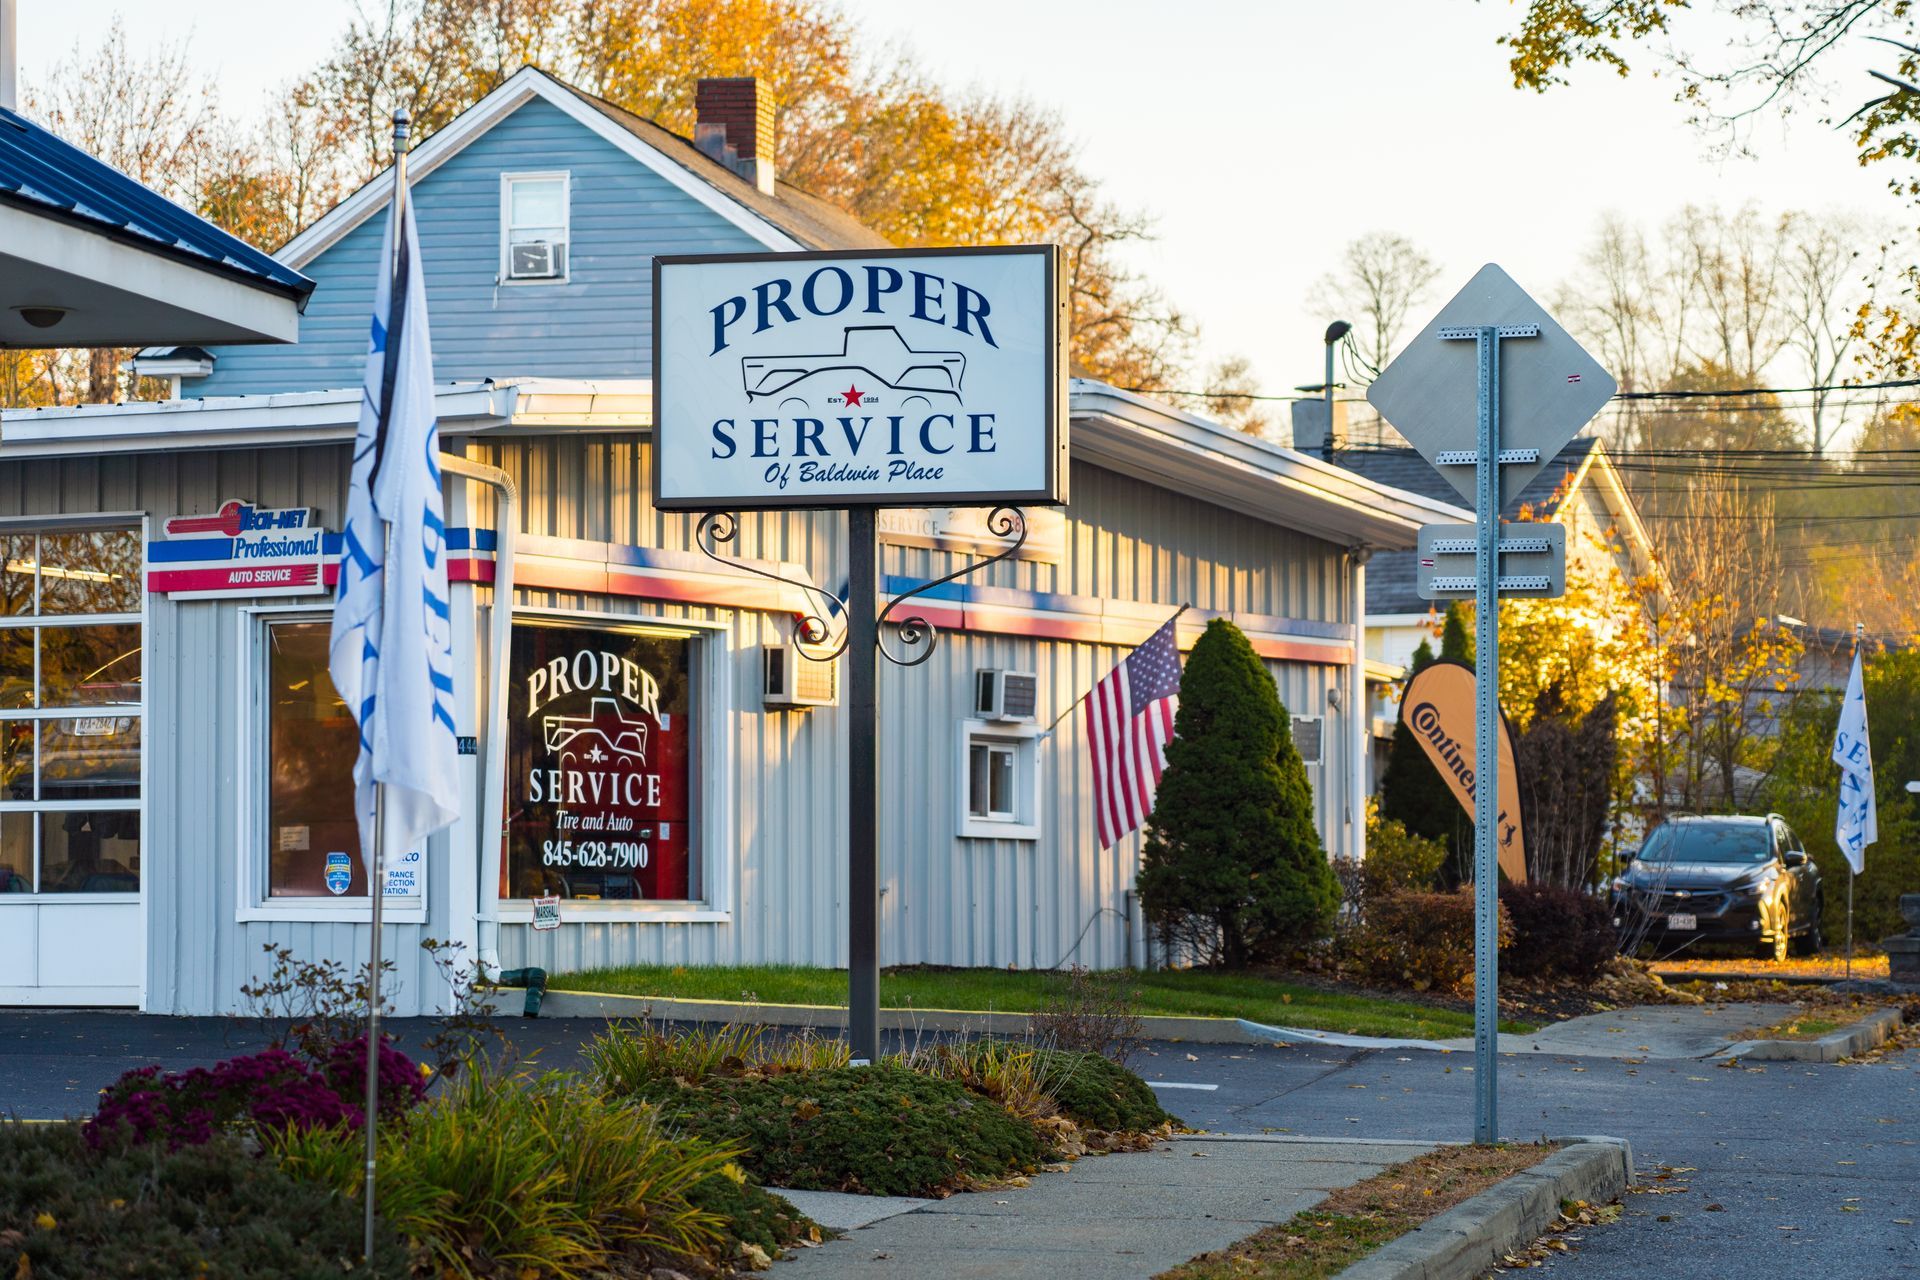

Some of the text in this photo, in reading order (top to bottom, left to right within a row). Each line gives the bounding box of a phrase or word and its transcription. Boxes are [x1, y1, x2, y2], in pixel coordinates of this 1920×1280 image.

[709, 265, 999, 357] PROPER
[711, 414, 997, 459] SERVICE
[764, 459, 945, 489] Of Baldwin Place
[235, 532, 318, 558] Professional
[228, 569, 291, 584] AUTO SERVICE
[527, 649, 662, 726] PROPER
[529, 768, 662, 807] SERVICE
[556, 810, 634, 832] Tire and Auto
[543, 840, 648, 868] 845-628-7900
